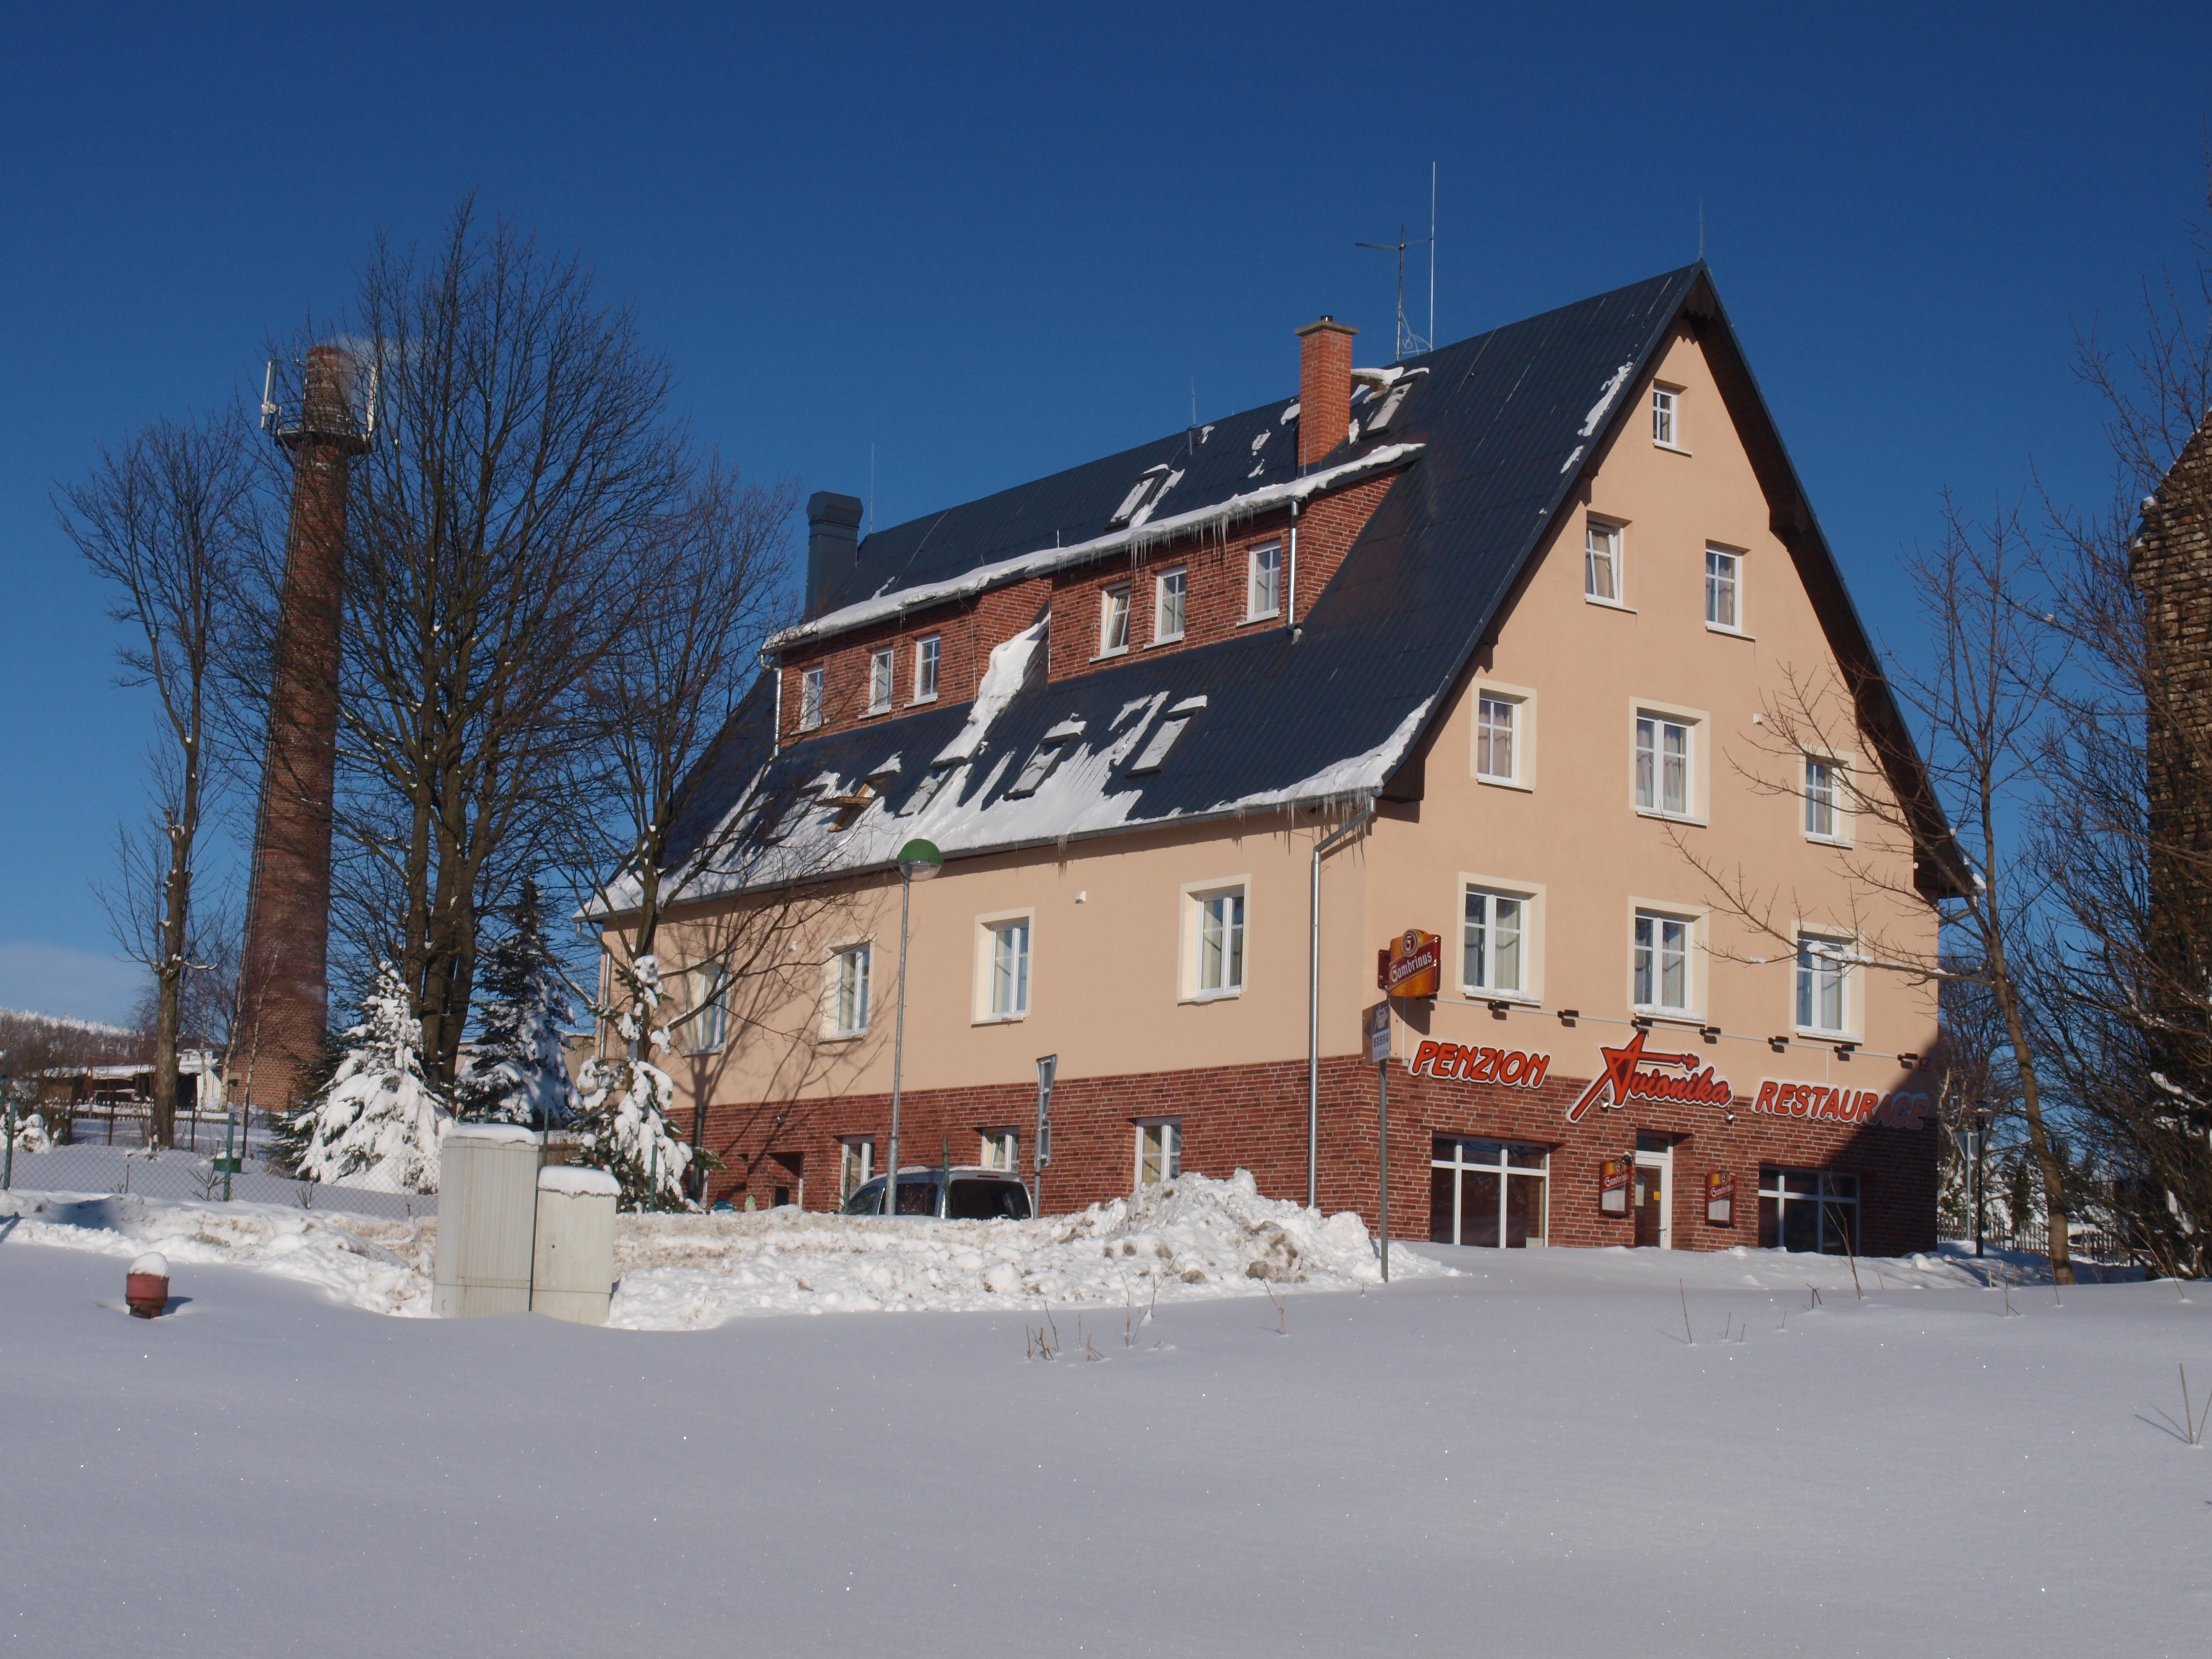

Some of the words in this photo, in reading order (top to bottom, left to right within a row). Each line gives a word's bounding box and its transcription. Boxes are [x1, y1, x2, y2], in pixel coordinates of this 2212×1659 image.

[1389, 951, 1433, 983] Gambrinus
[1411, 1039, 1552, 1087] PENZION
[1569, 1030, 1732, 1121] Avionika
[1754, 1080, 1930, 1129] RESTAURACE
